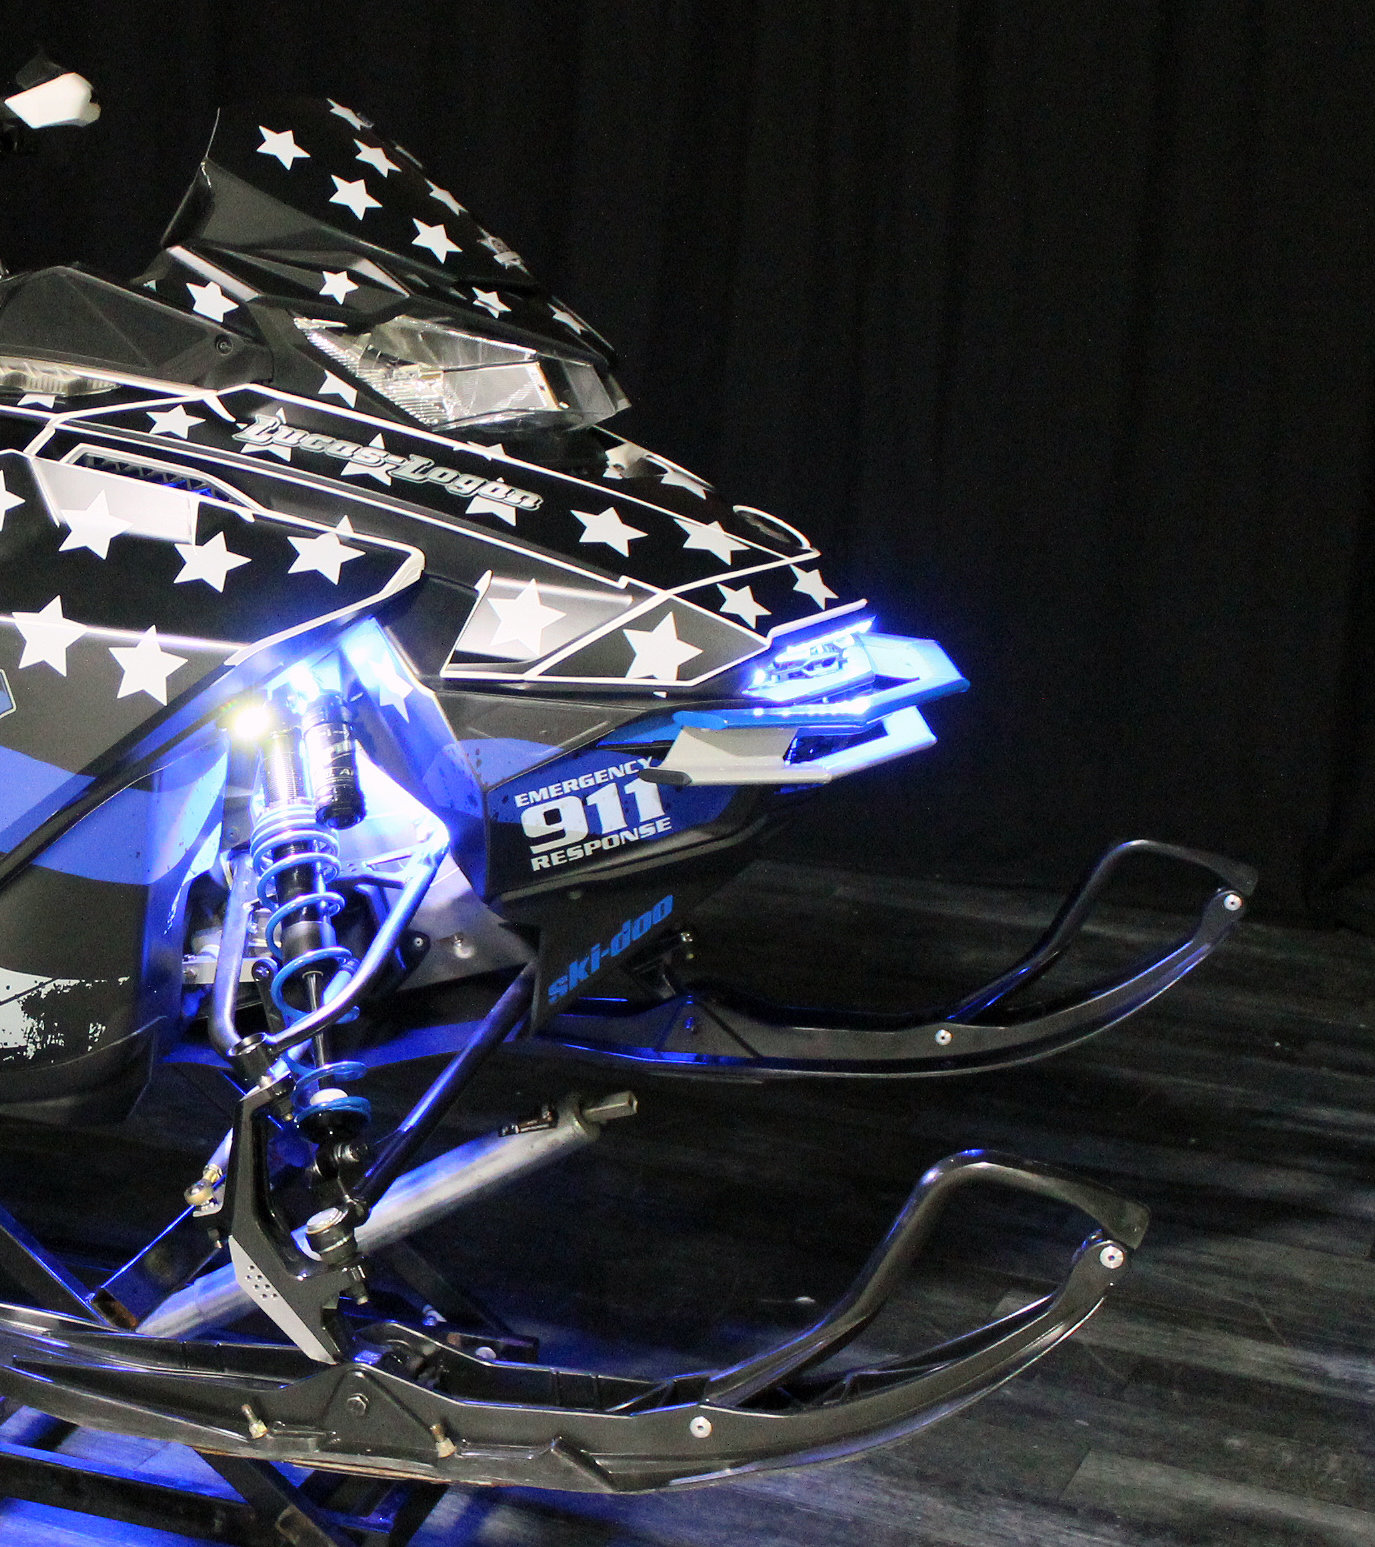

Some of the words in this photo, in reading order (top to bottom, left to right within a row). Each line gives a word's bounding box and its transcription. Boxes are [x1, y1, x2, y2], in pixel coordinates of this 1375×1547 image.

[232, 414, 543, 511] Lucas-Logan
[514, 756, 653, 807] EMERGENCY
[521, 777, 666, 854] 911
[530, 817, 672, 871] RESPONSE
[548, 895, 674, 1004] ski-doo
